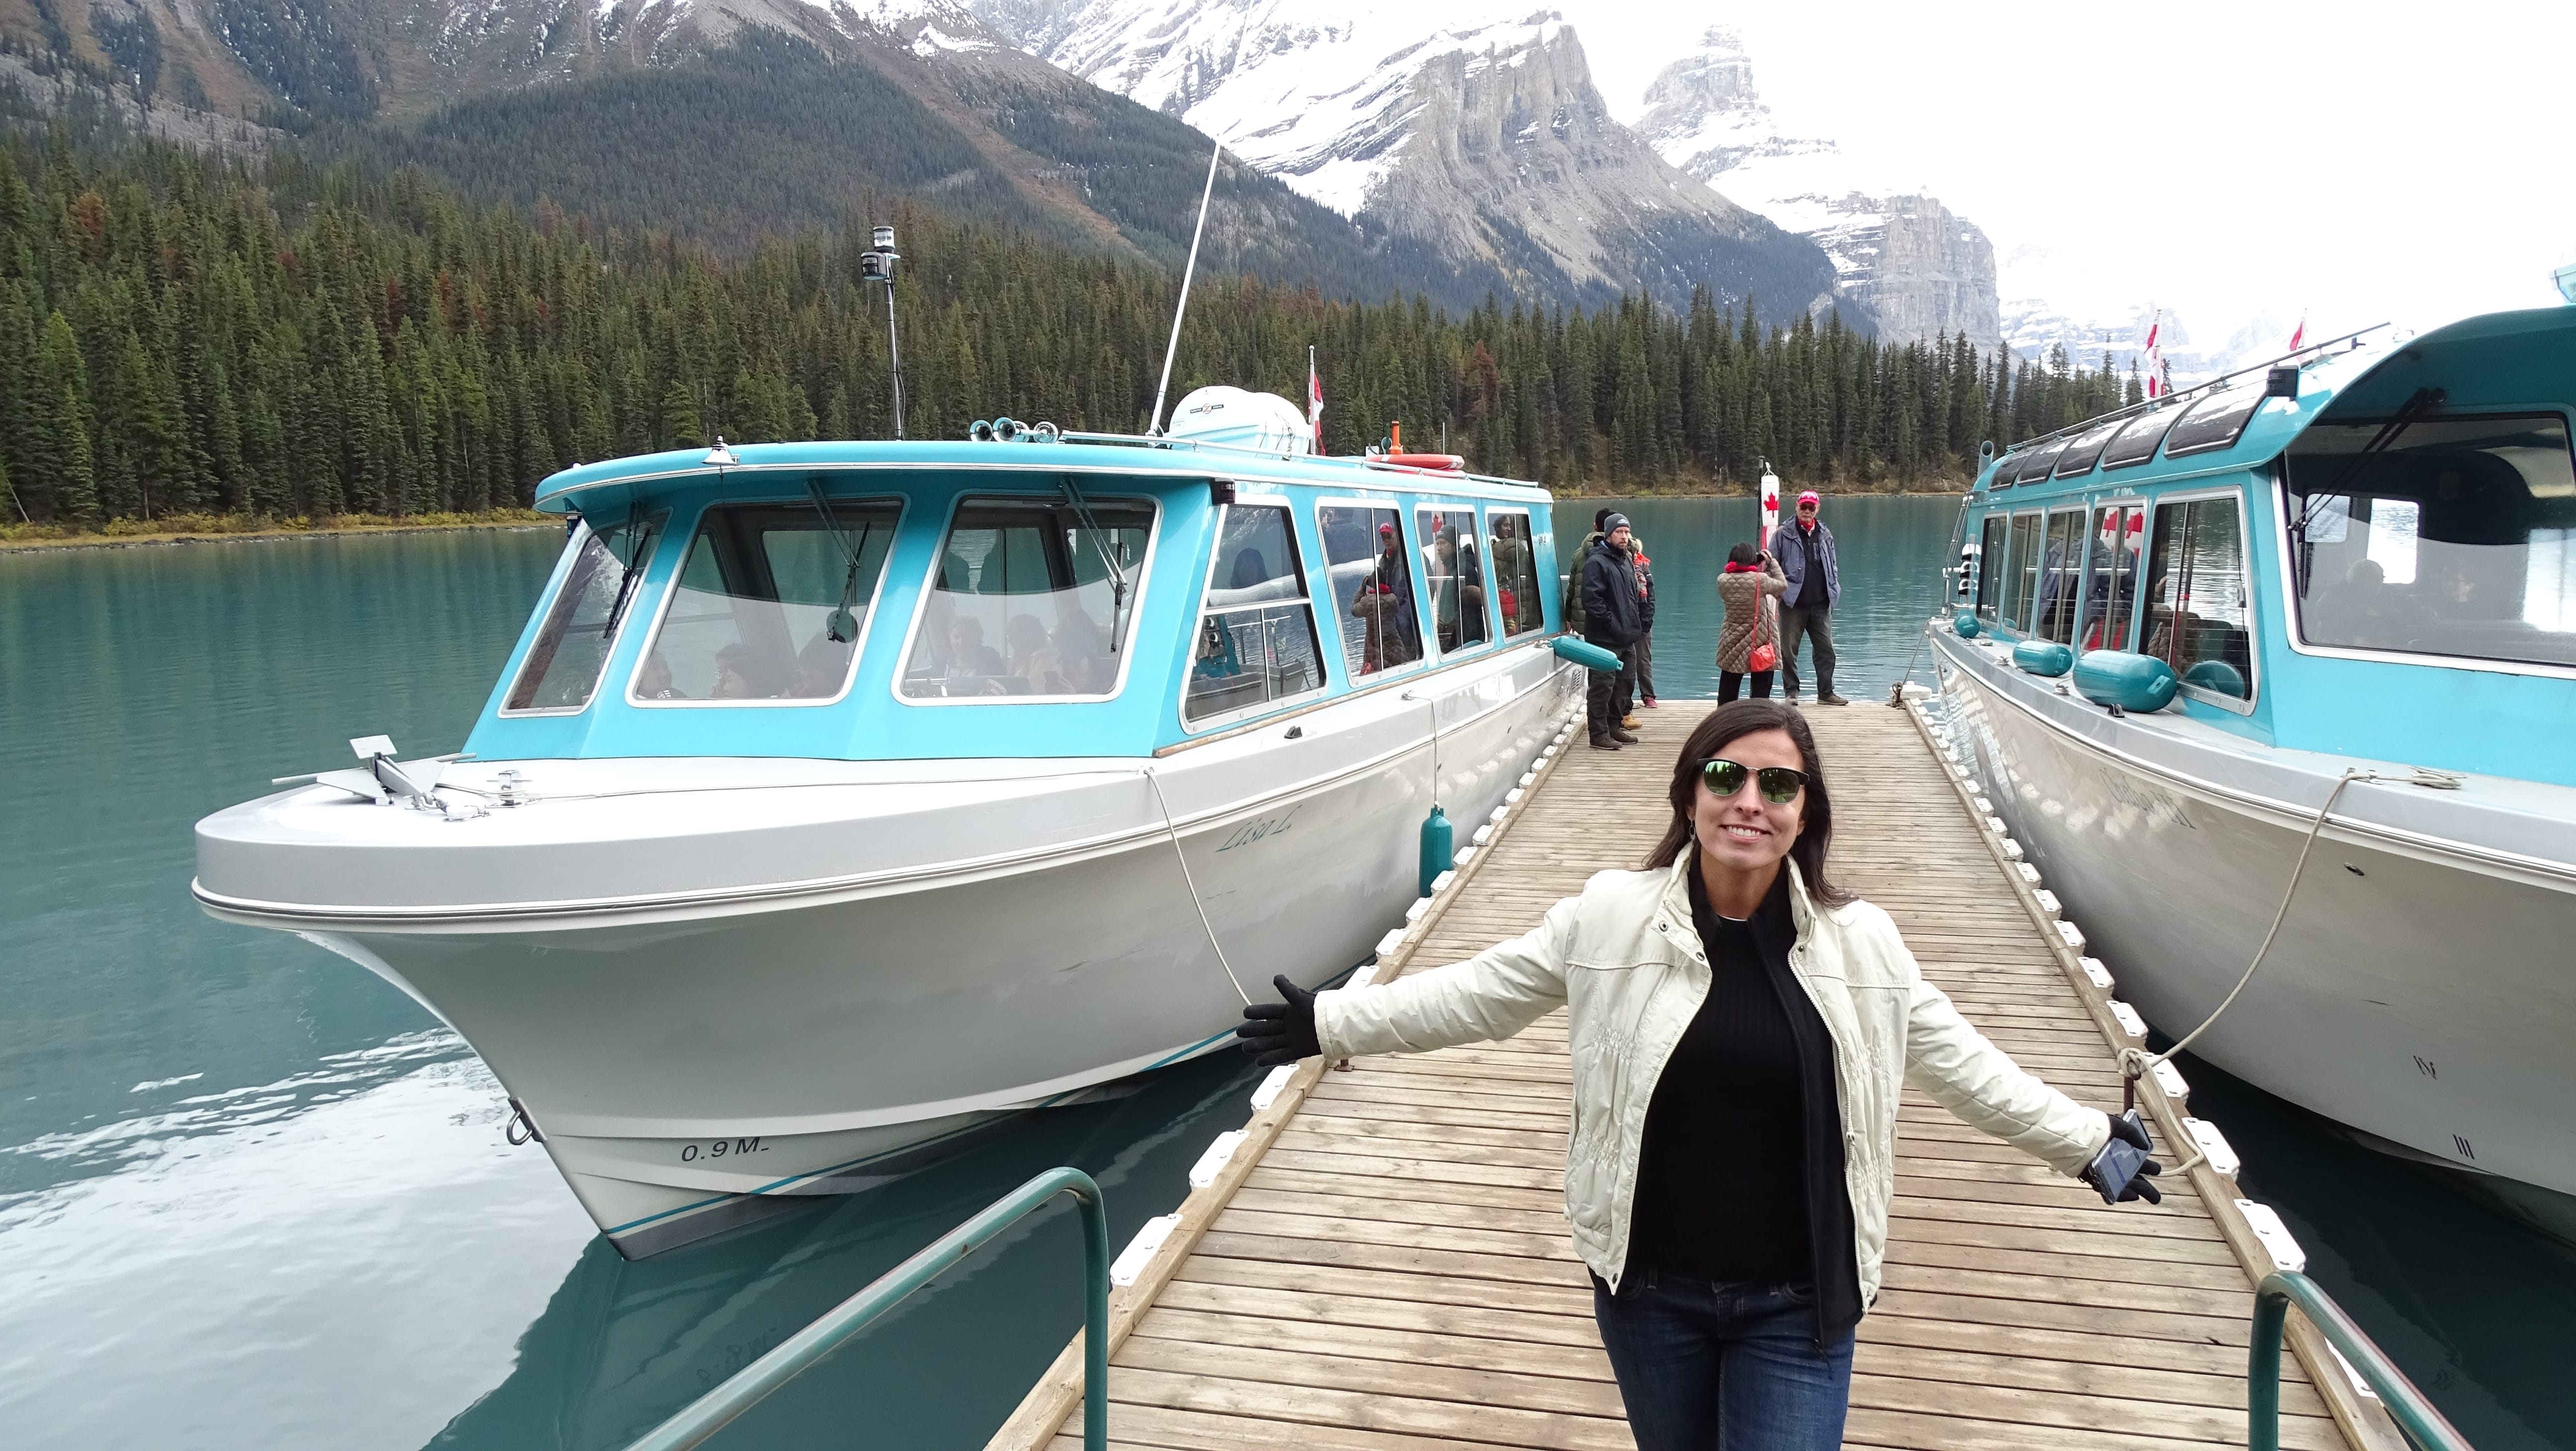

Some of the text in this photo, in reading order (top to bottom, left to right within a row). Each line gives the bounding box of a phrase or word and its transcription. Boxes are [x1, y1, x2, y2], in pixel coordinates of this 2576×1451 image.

[1214, 804, 1303, 853] Lisa L.
[2452, 1133, 2475, 1160] III
